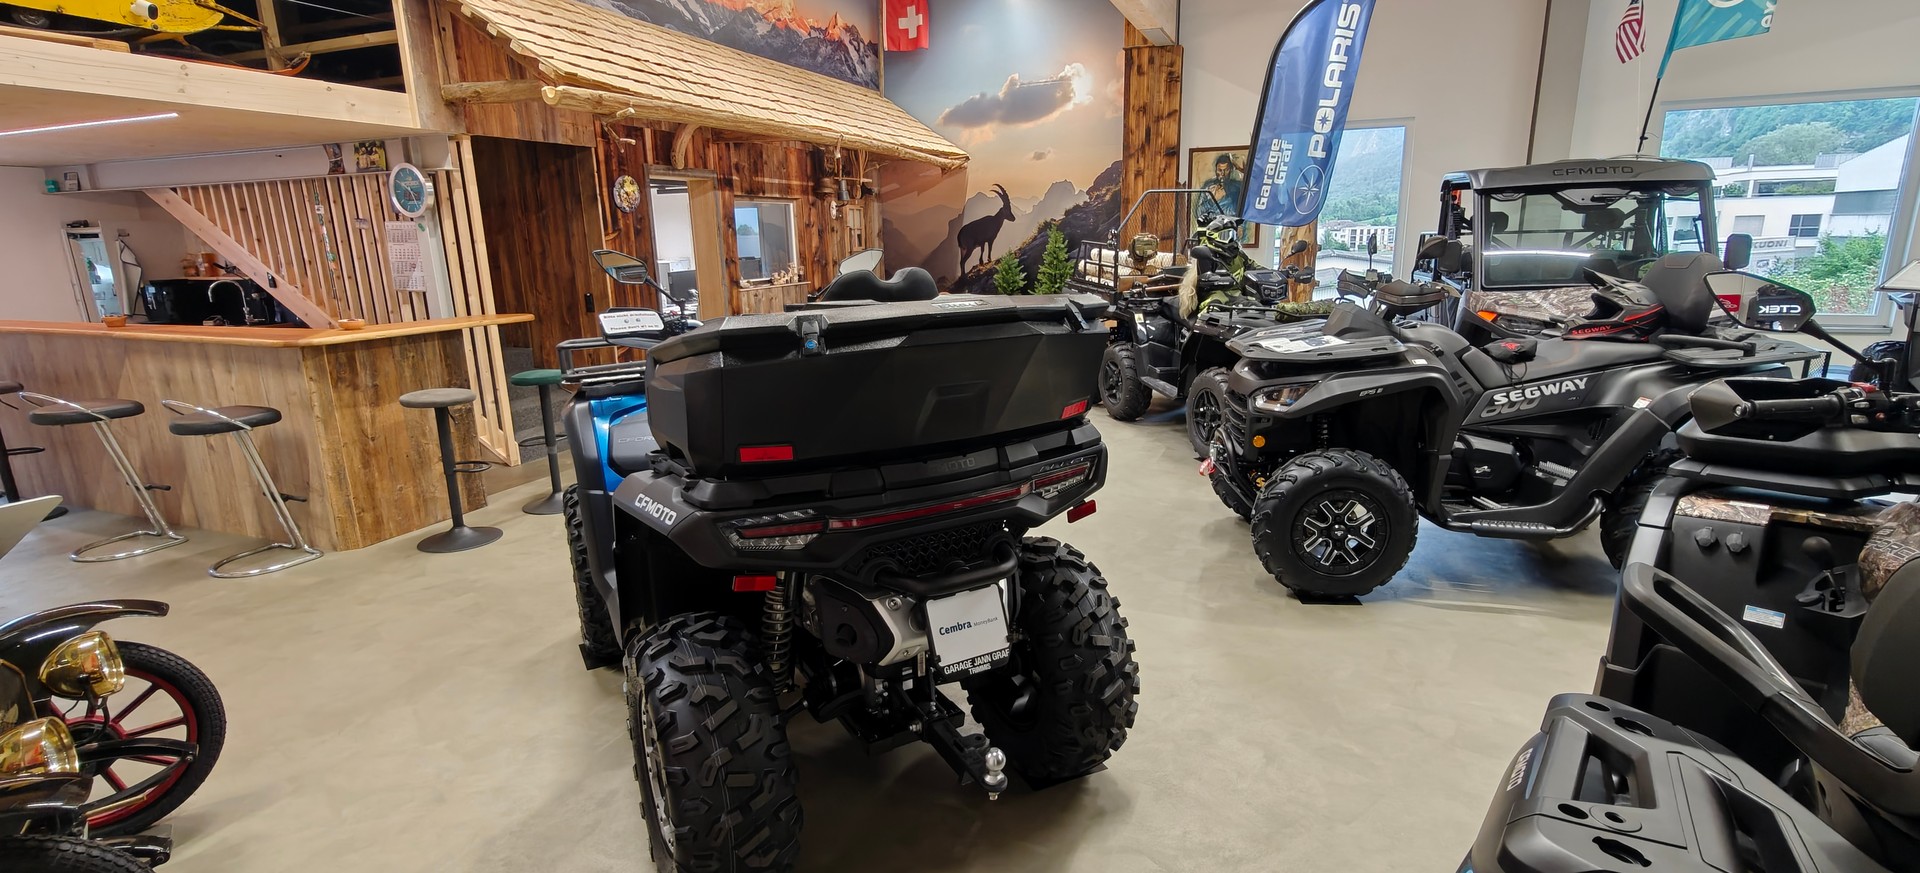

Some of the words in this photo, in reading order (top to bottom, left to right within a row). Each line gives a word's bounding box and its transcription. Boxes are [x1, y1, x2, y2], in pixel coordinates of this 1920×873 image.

[1308, 3, 1361, 159] POLARIS
[1254, 138, 1282, 211] Garage
[1273, 139, 1294, 185] Graf
[1552, 166, 1634, 176] CFMOTO
[1571, 325, 1612, 335] SEGWAY
[1492, 377, 1589, 405] SEGWAY
[634, 493, 677, 526] CFMOTO
[939, 621, 972, 636] Cembra
[973, 616, 998, 627] MoneyBank
[943, 659, 973, 675] GARAGE
[973, 654, 992, 666] JANN
[991, 648, 1010, 661] GRAF
[968, 662, 992, 675] TRIMMIS
